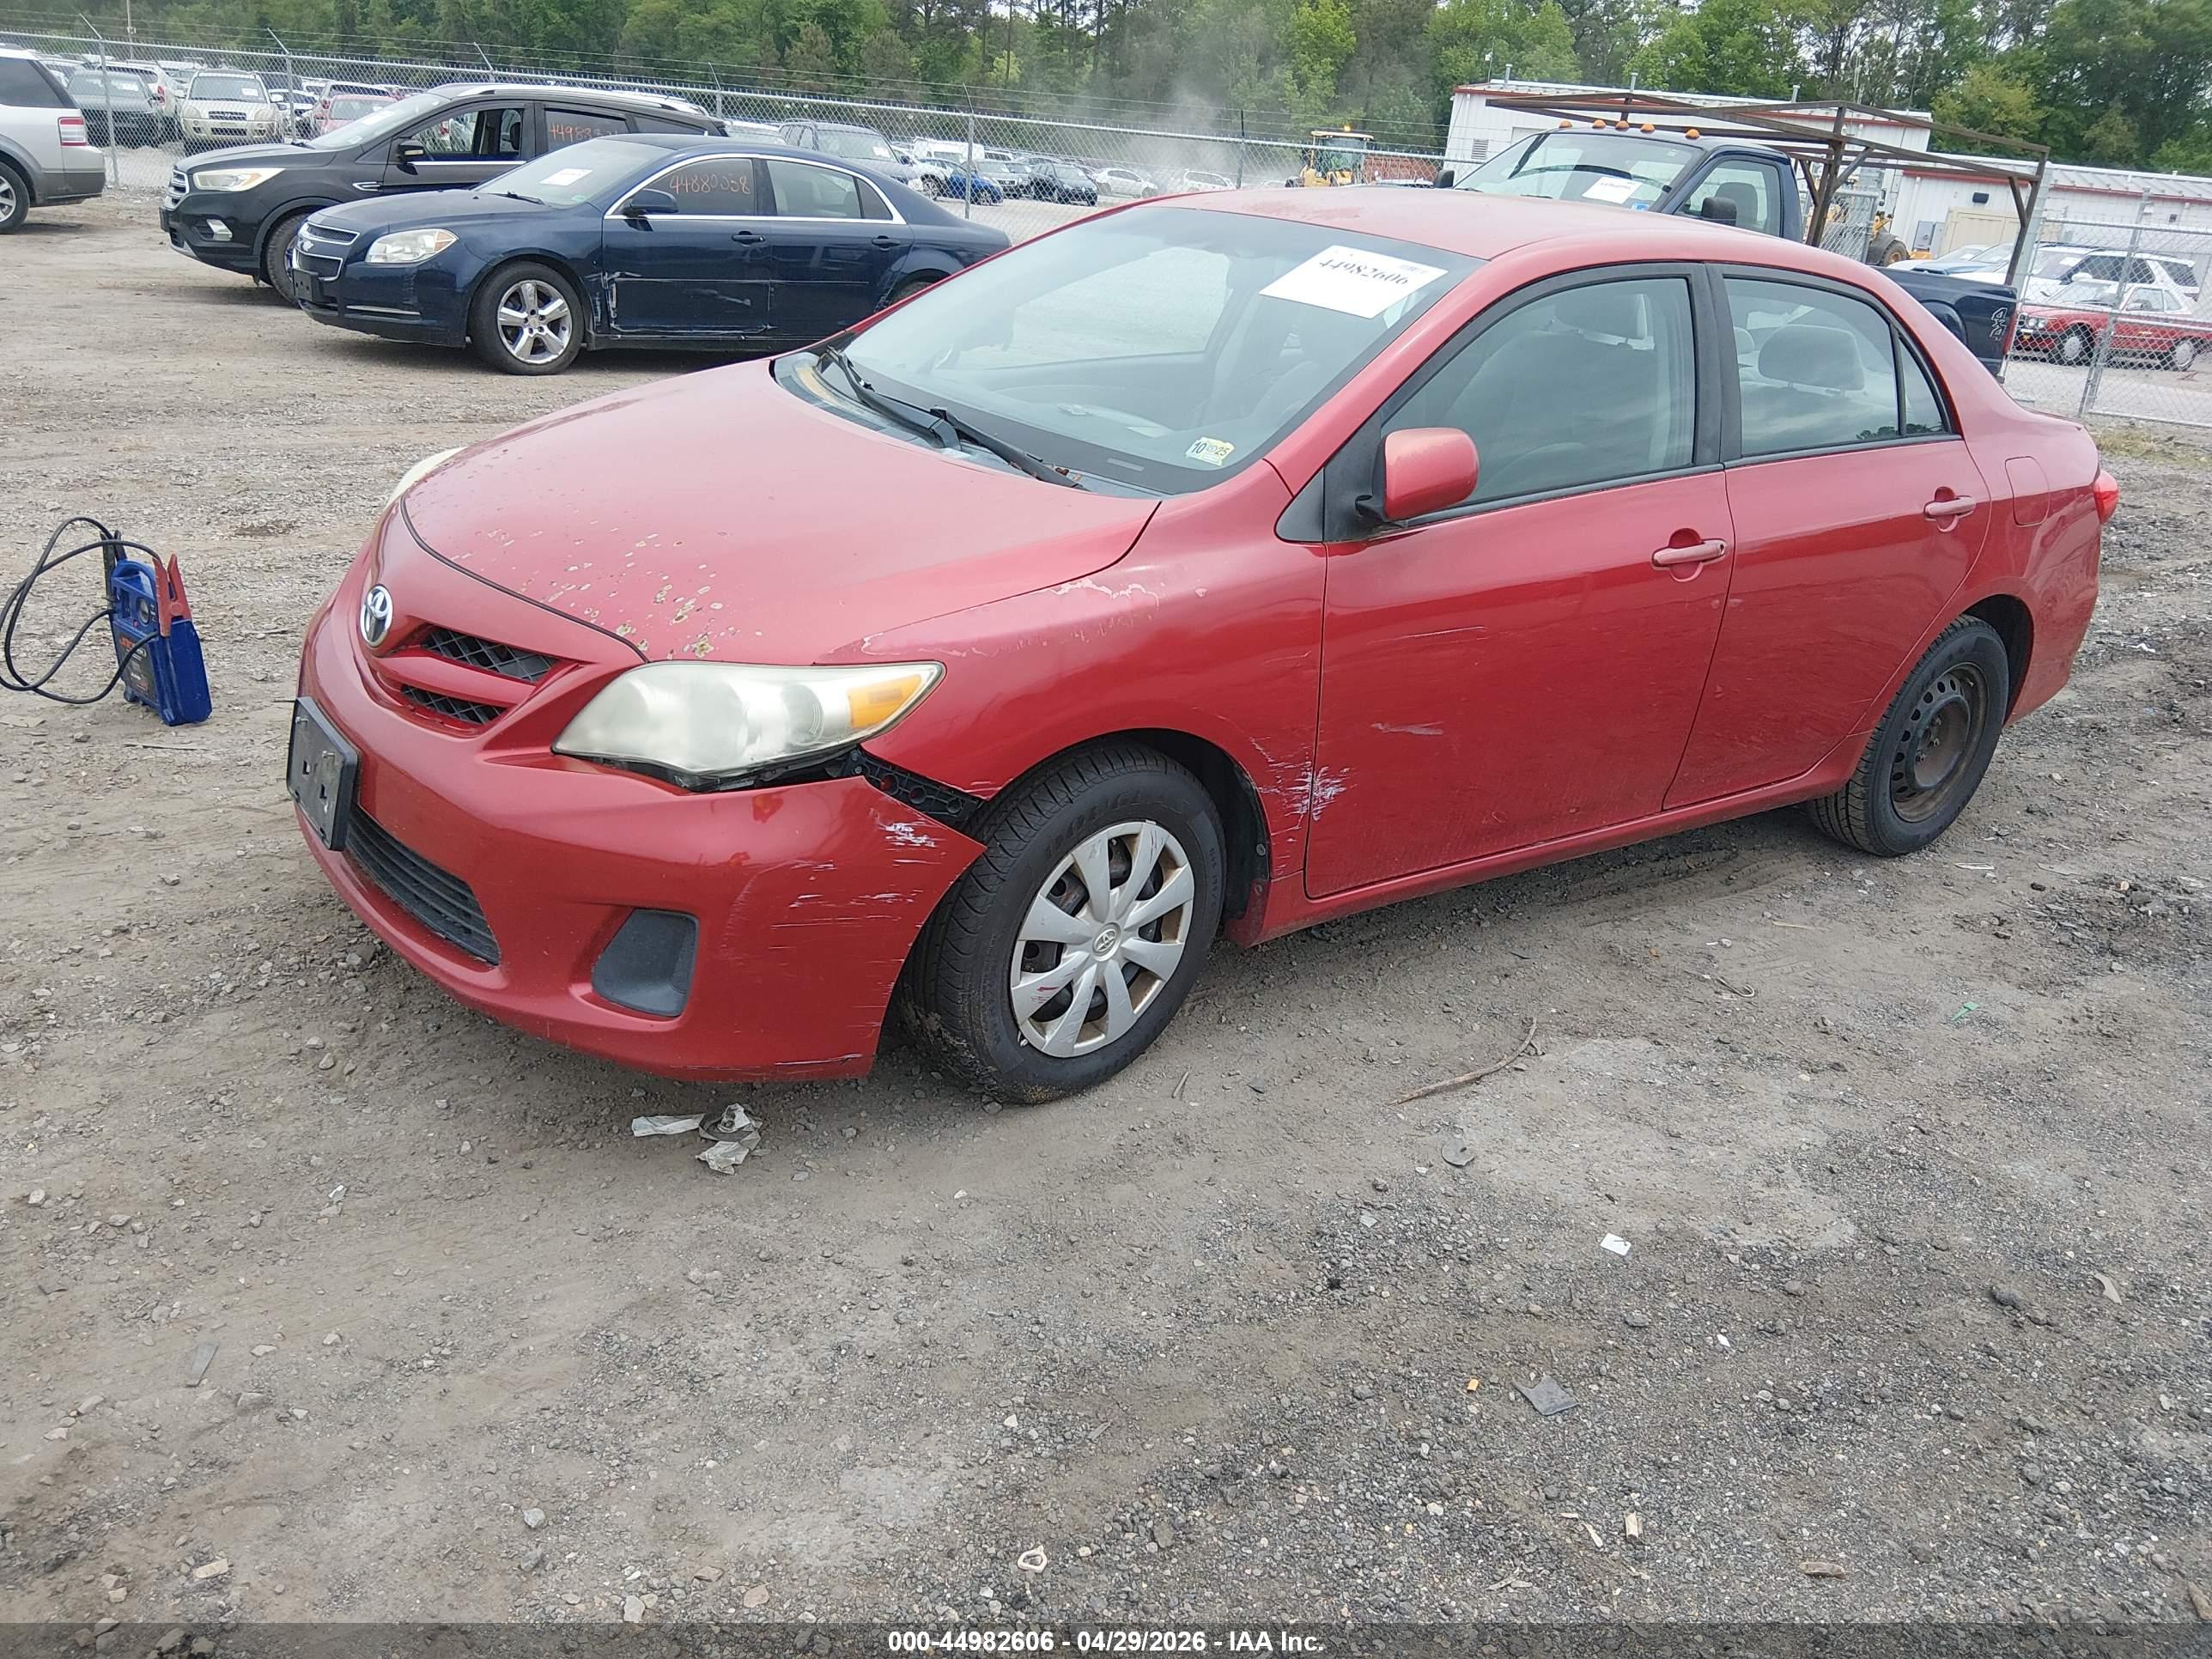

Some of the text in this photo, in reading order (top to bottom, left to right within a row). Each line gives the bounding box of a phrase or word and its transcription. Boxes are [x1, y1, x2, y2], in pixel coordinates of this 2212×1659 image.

[1319, 259, 1409, 286] 44982606
[1191, 441, 1231, 456] 10 25
